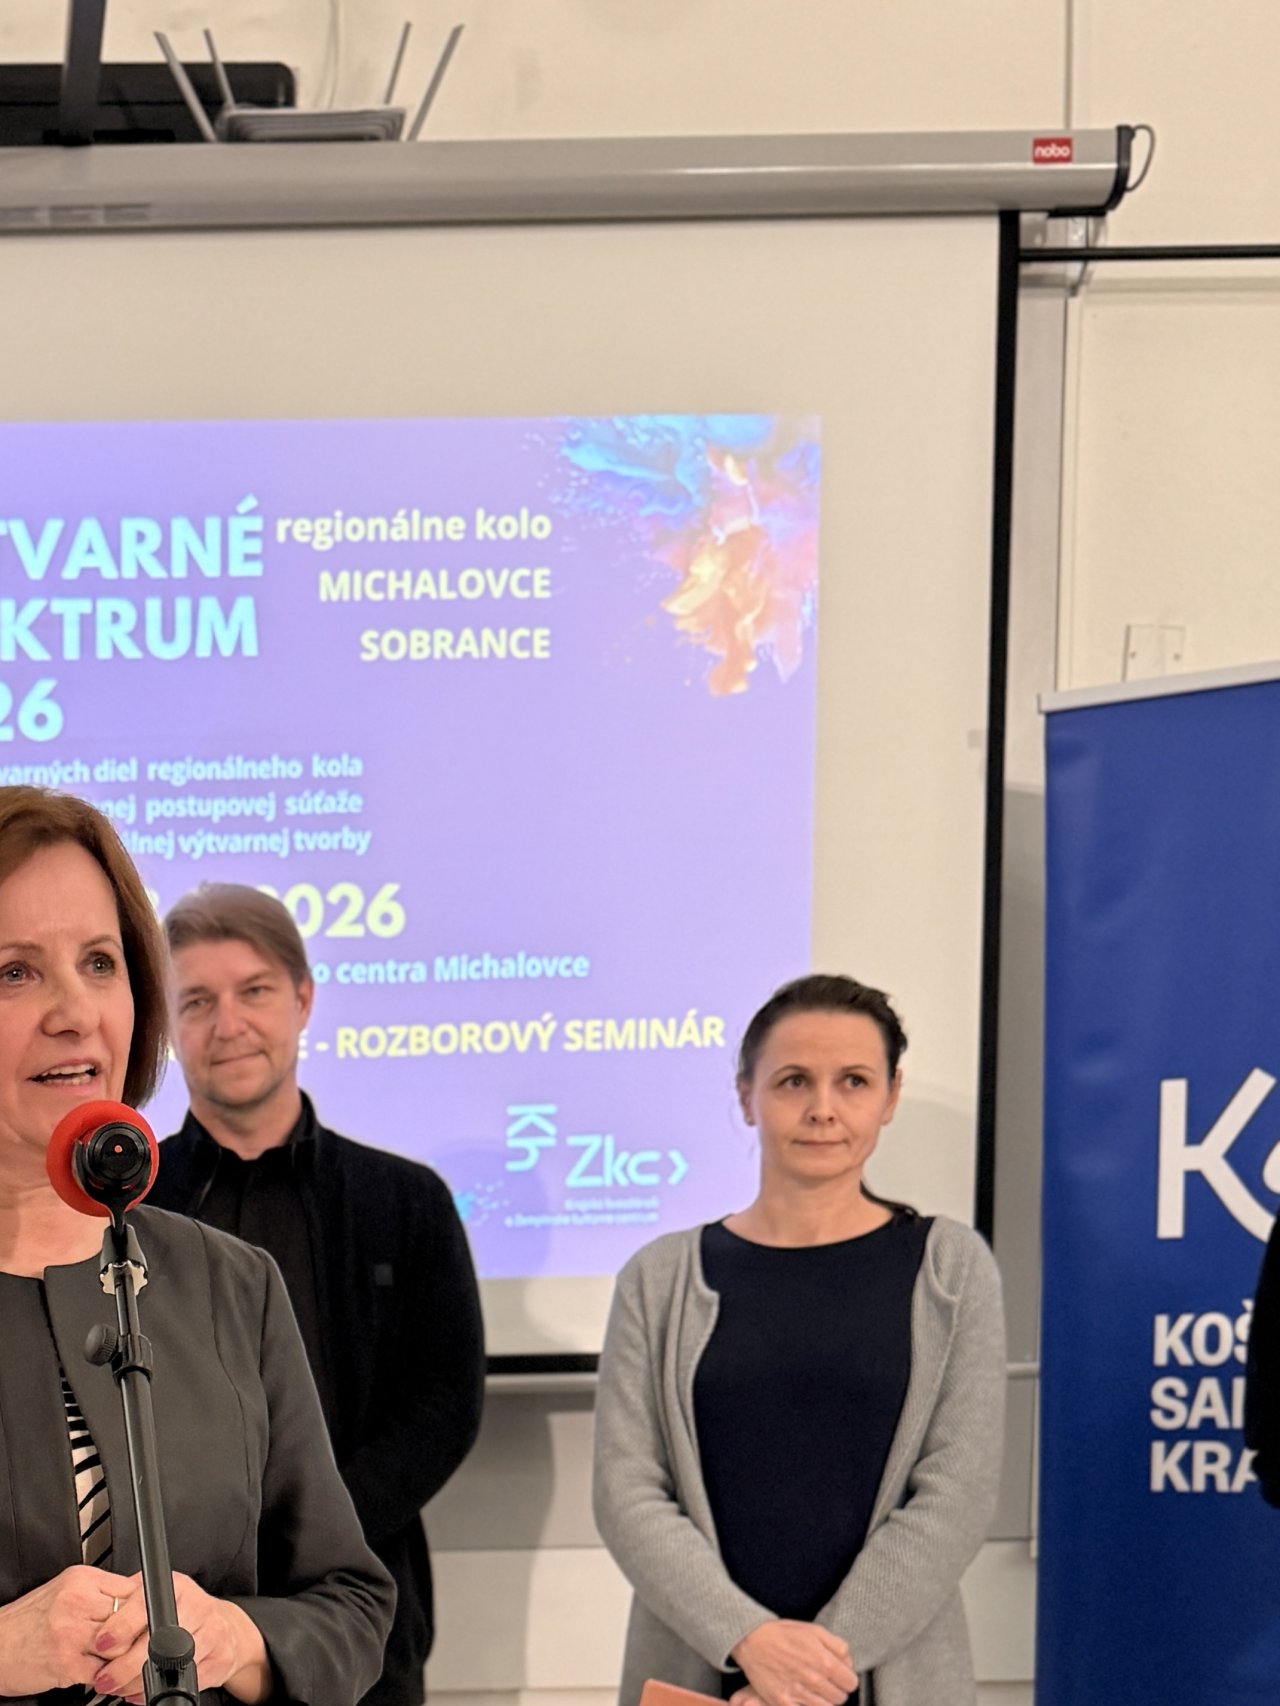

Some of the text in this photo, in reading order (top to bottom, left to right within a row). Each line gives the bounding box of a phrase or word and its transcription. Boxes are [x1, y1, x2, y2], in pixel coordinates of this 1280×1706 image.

[1035, 143, 1070, 158] nobo
[276, 507, 552, 551] regionálne kolo
[319, 568, 552, 602] MICHALOVCE
[360, 628, 551, 661] SOBRANCE
[94, 757, 138, 782] diel
[147, 755, 303, 787] regionálneho
[312, 754, 363, 779] kola
[145, 792, 276, 824] postupovej
[284, 790, 363, 816] súťaže
[178, 827, 290, 860] výtvarnej
[293, 825, 372, 856] tvorby
[257, 882, 407, 939] 026
[335, 958, 428, 984] centra
[433, 951, 591, 983] Michalovce
[336, 1012, 558, 1058] ROZBOROVÝ
[563, 1007, 726, 1052] SEMINÁR
